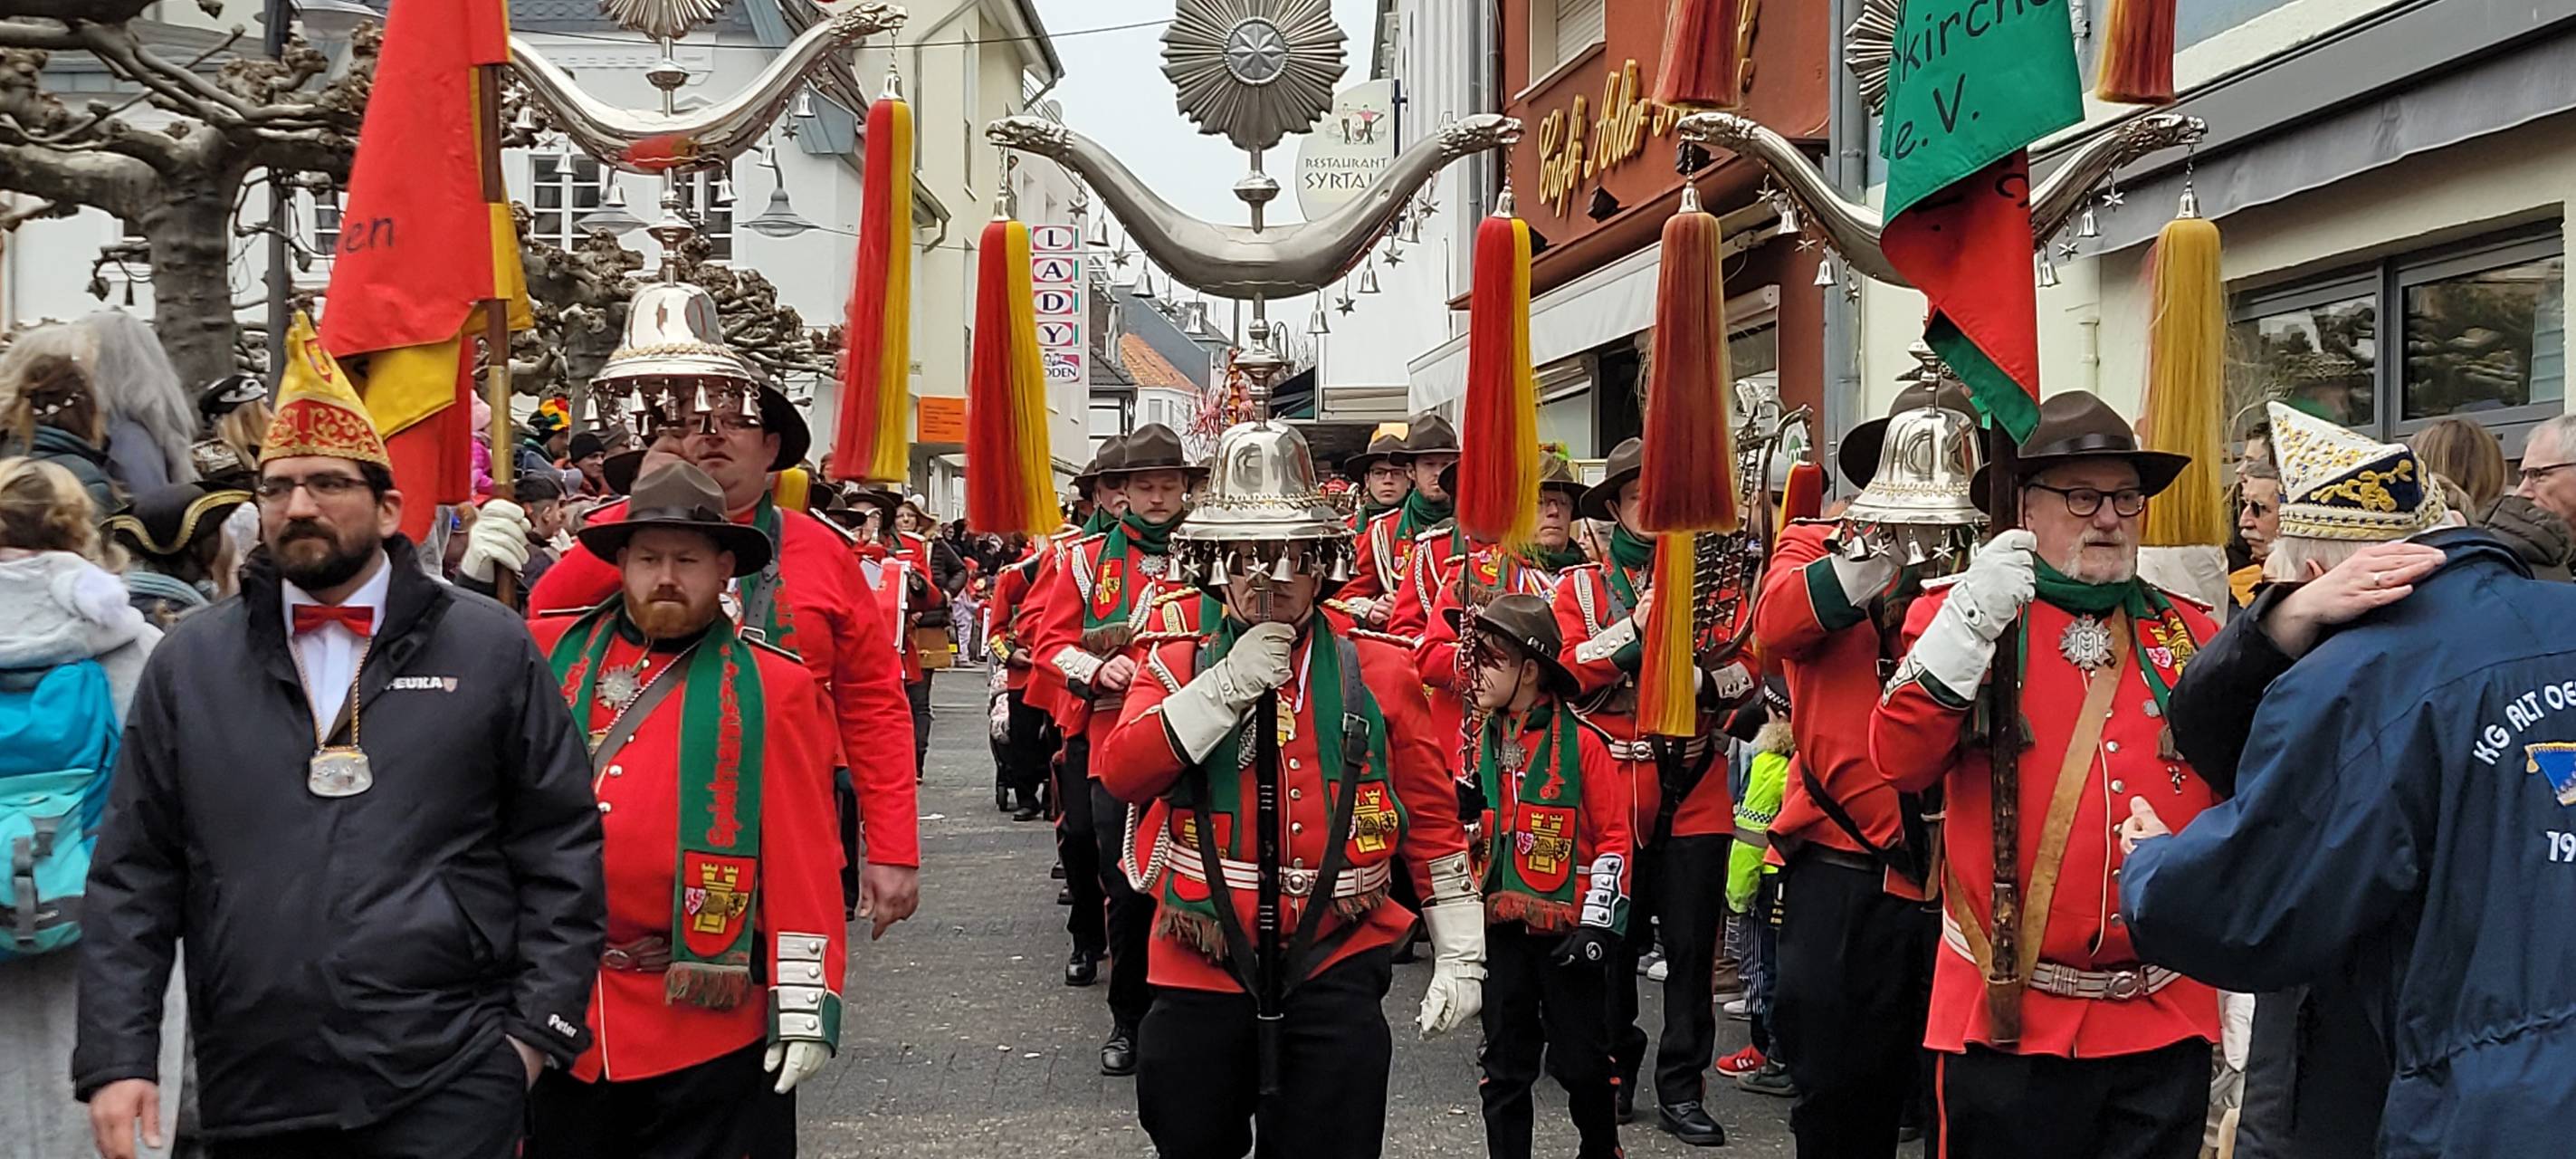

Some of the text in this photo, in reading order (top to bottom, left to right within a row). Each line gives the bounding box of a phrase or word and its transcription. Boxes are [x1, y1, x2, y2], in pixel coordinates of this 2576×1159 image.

[1305, 157, 1388, 168] RESTAURANT
[1042, 229, 1064, 343] LADY
[1043, 367, 1077, 378] ODEN
[385, 676, 444, 691] EUKA
[2473, 680, 2576, 765] KG ALT OE
[548, 1013, 577, 1039] Peter
